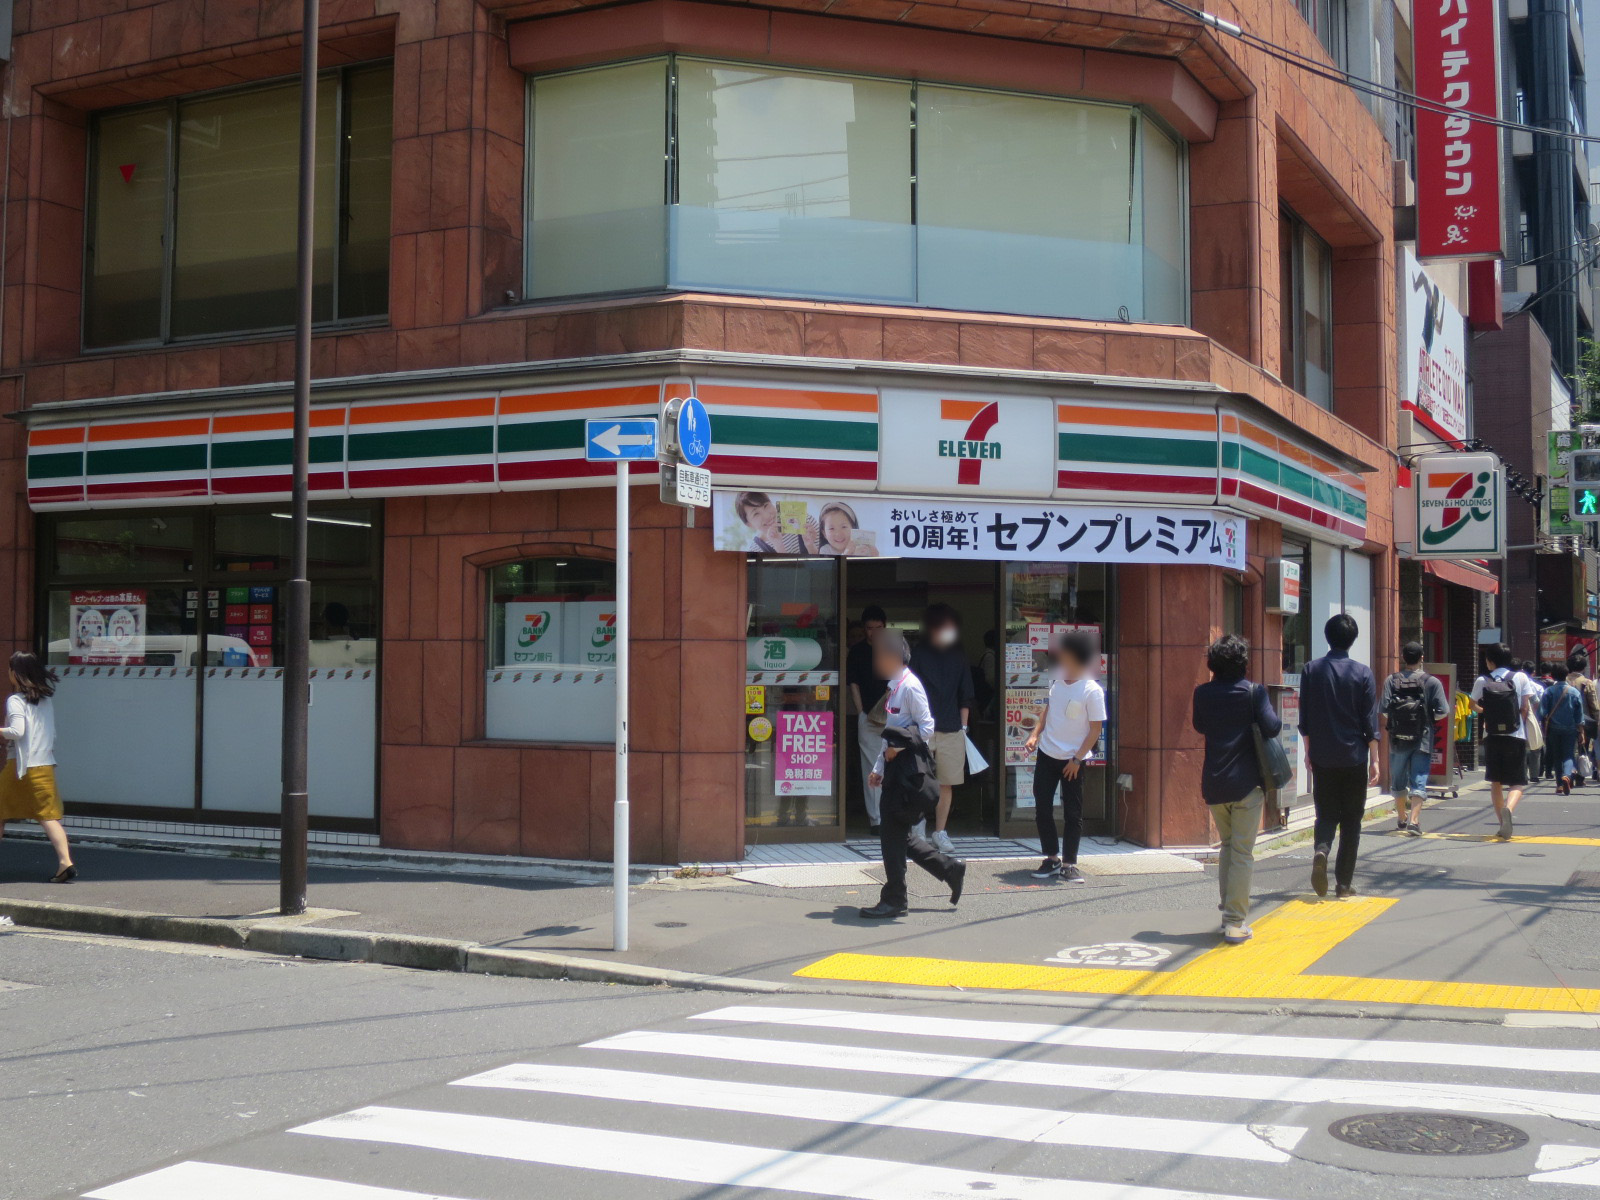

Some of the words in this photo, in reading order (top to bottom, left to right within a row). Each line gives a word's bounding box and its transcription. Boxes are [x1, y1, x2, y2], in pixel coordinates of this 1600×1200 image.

[679, 485, 709, 502] ここから
[890, 508, 979, 524] おいしさ極めて
[986, 511, 1222, 556] セブンプレミアム
[522, 626, 543, 635] BANK
[763, 640, 786, 660] 酒
[1542, 641, 1565, 649] カリー
[513, 652, 553, 662] セブン銀行
[764, 661, 787, 669] liquor
[782, 714, 827, 733] TAX-
[782, 735, 827, 753] FREE
[790, 754, 819, 764] SHOP
[784, 769, 823, 779] 免税商店
